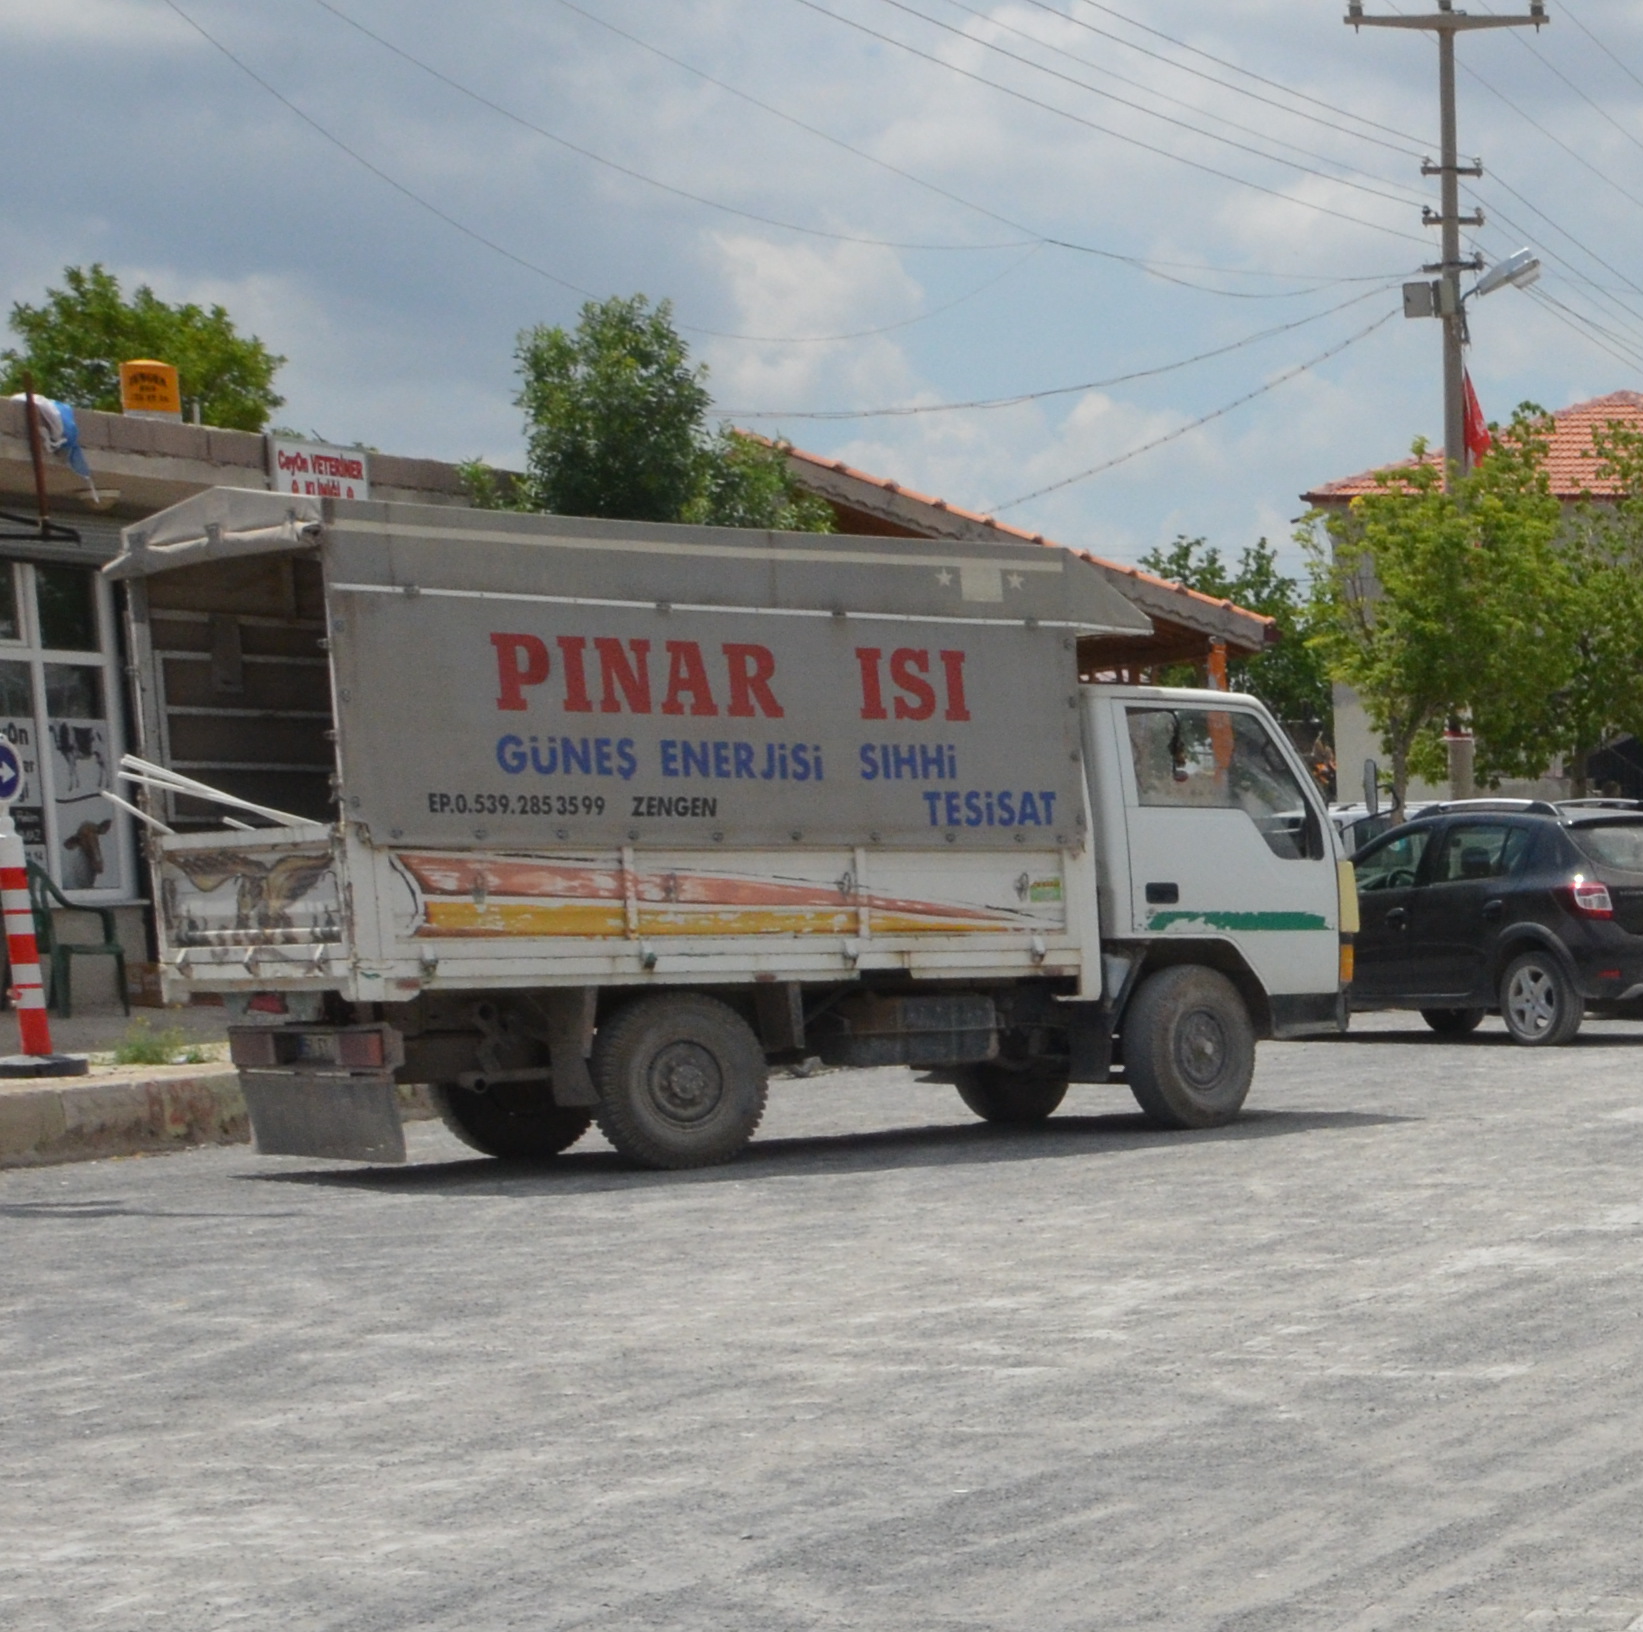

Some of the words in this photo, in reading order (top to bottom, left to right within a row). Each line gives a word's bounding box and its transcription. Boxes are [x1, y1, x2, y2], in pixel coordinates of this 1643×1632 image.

[490, 632, 784, 718] PINAR
[855, 647, 971, 721] ISI
[496, 734, 638, 781] GÜNEŞ
[631, 796, 717, 817] ZENGEN
